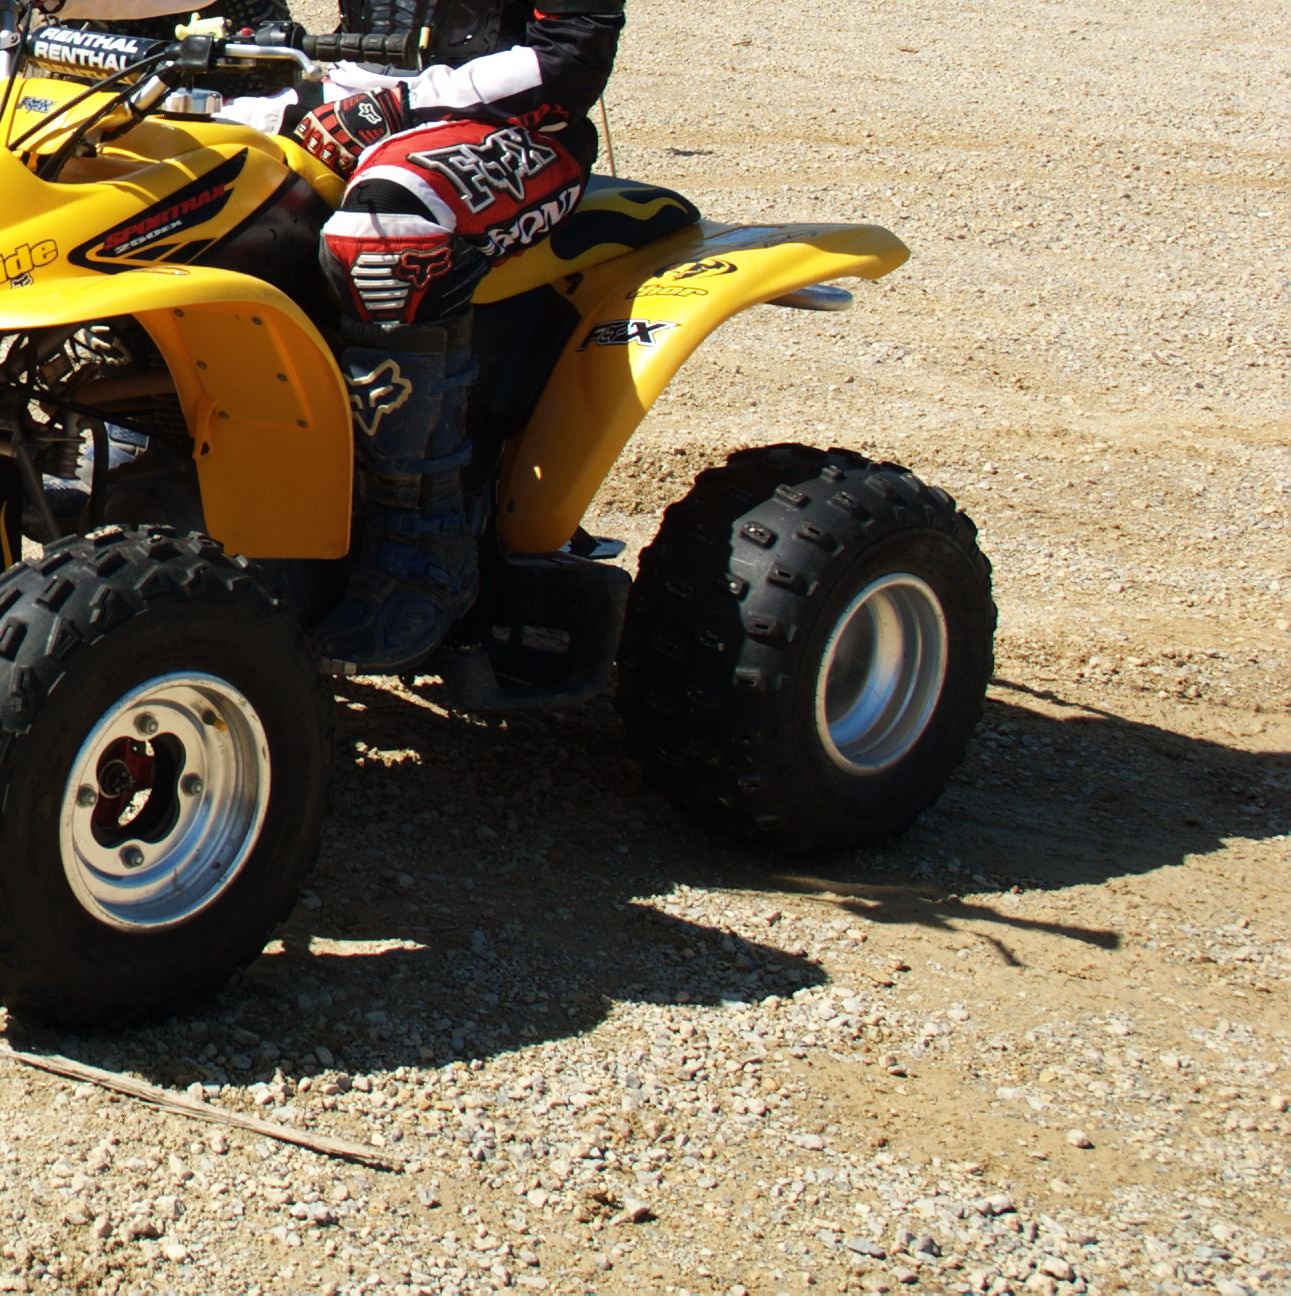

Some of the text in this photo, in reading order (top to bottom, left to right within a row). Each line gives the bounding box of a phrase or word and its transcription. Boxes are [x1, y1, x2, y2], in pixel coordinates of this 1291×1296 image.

[39, 27, 139, 54] RENTHAL
[102, 184, 226, 251] SPORTRAX
[114, 219, 183, 255] 250EX
